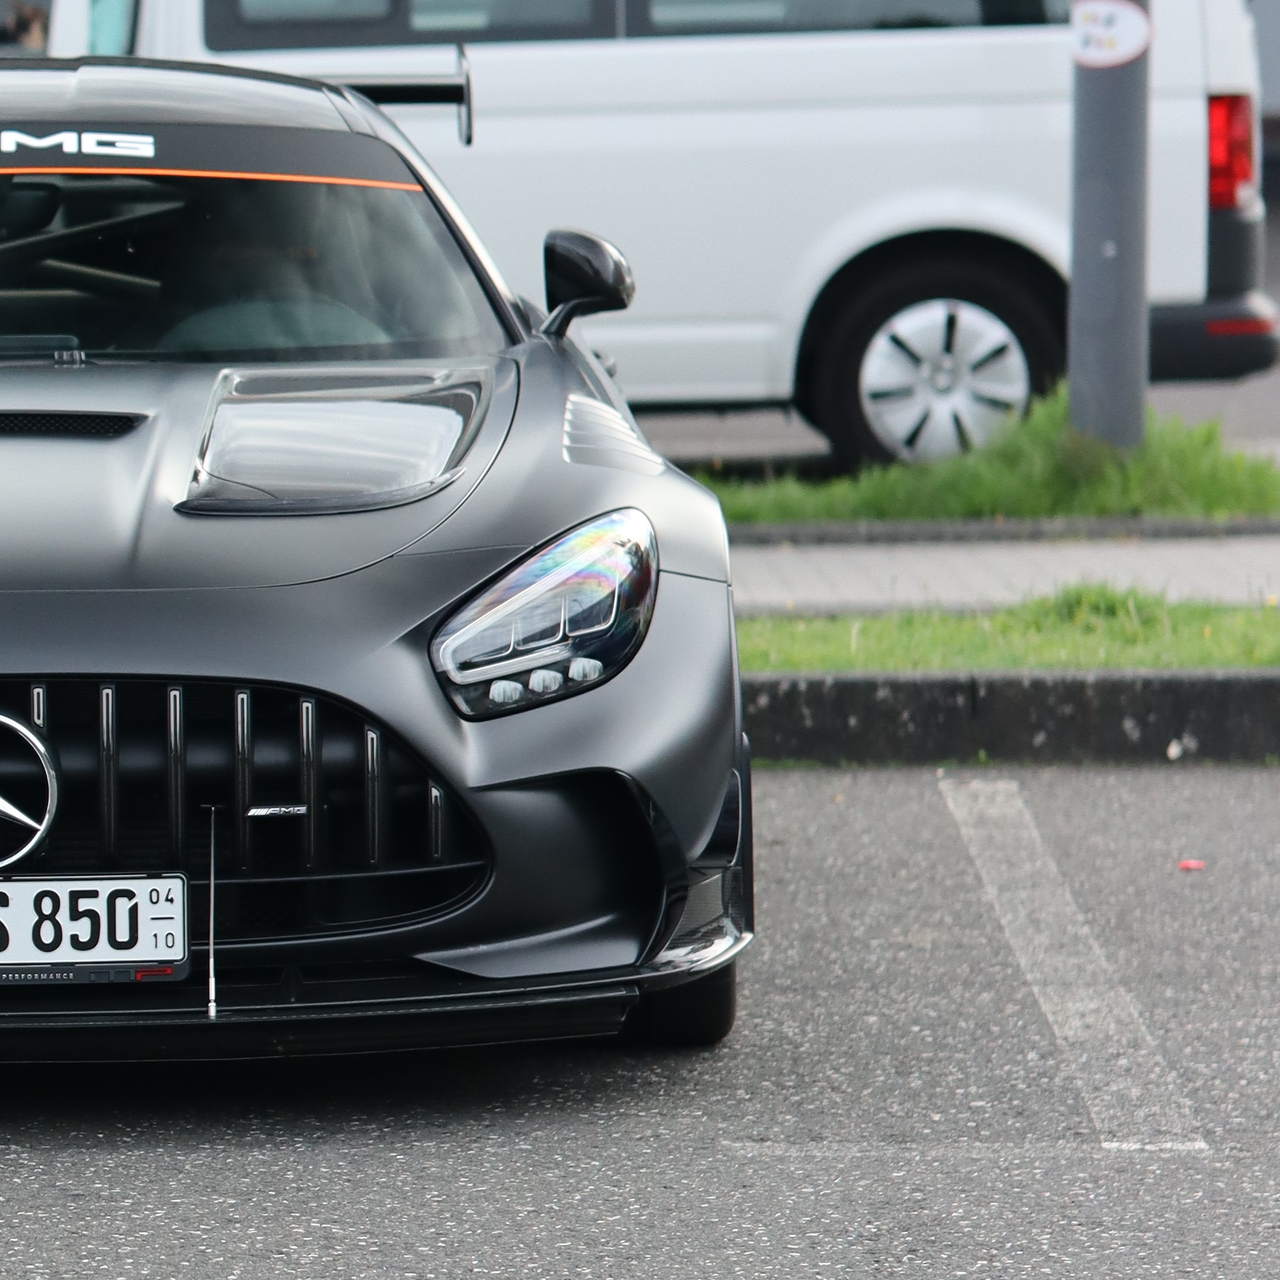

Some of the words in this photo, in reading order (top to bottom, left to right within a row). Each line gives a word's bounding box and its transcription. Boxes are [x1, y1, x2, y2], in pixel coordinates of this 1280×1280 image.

[265, 806, 308, 816] AMG
[149, 888, 175, 905] 04
[32, 889, 139, 953] 850
[152, 932, 175, 950] 10
[2, 972, 74, 982] PERFORMANCE
